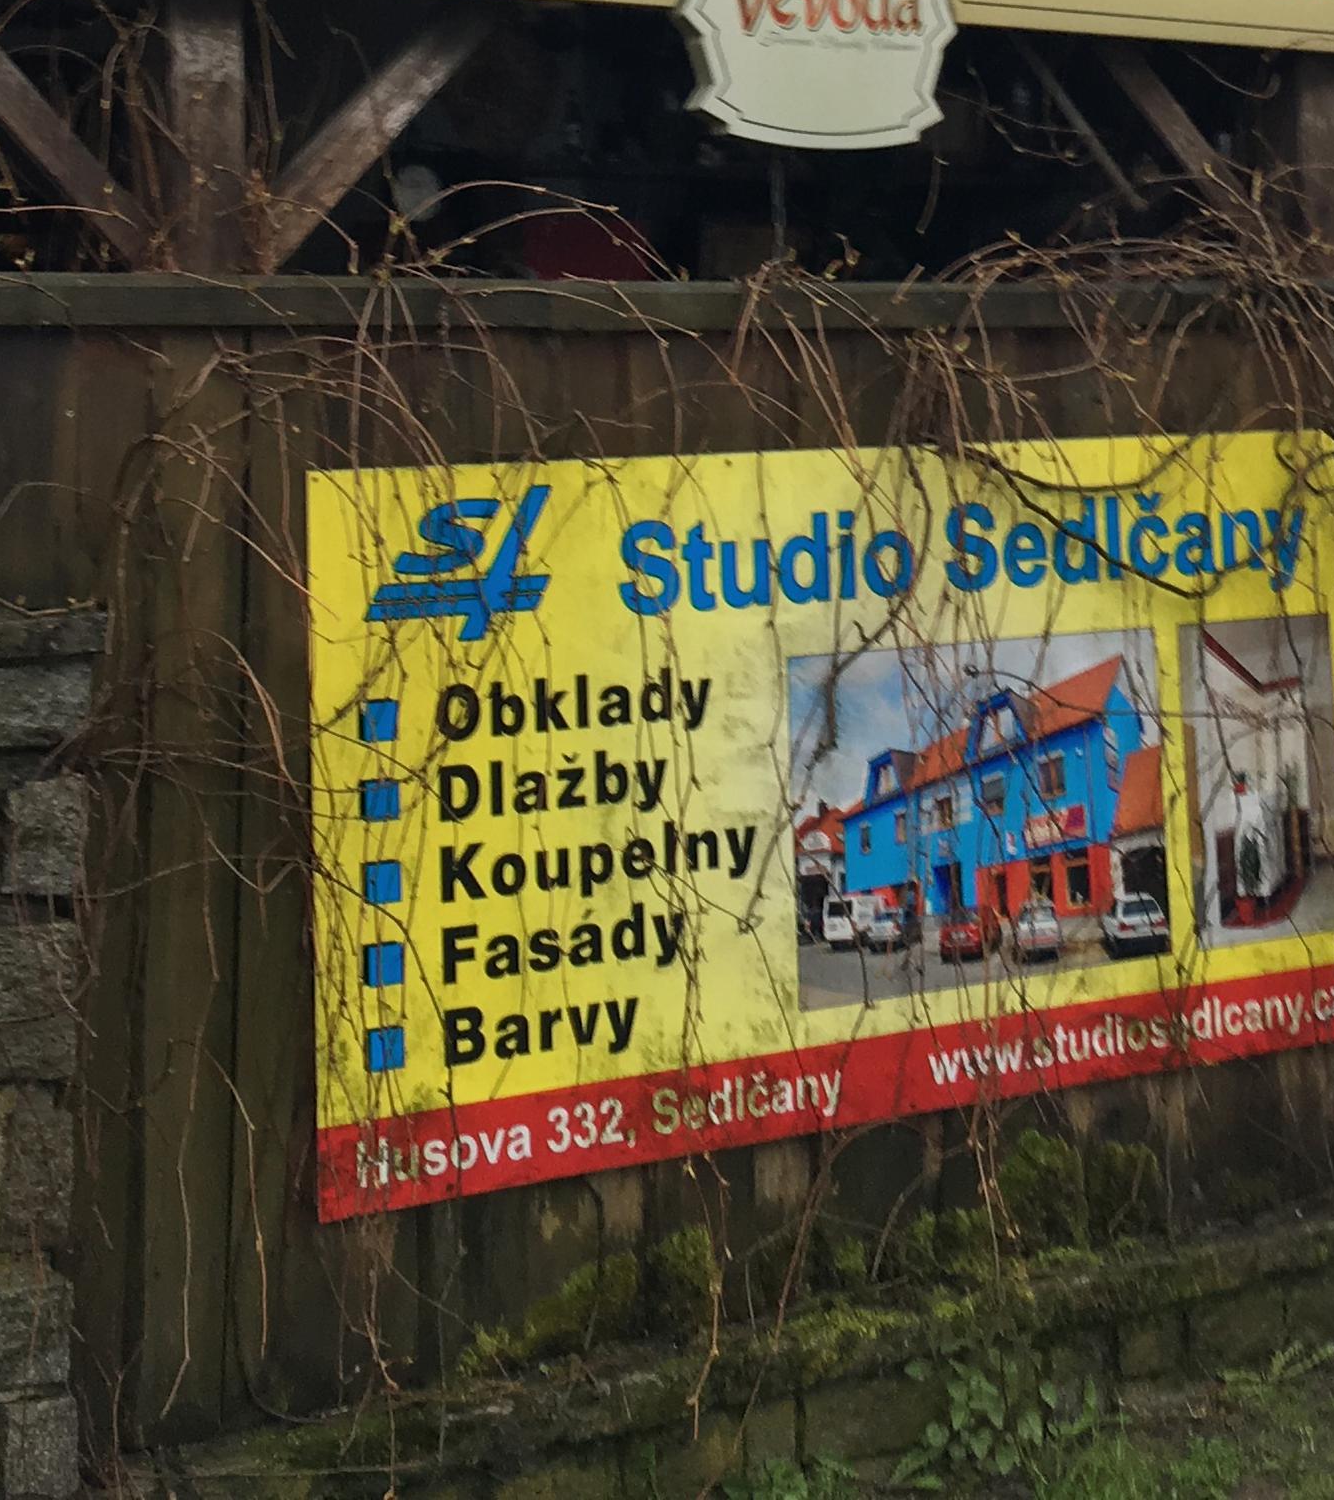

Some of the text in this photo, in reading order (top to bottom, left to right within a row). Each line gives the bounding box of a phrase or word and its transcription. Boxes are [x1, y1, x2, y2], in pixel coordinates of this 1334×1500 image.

[619, 492, 1306, 617] Studio Sedlčany
[438, 667, 711, 742] Obklady
[438, 751, 668, 823] Dlažby
[439, 820, 756, 903] Koupelny
[441, 902, 685, 985] Fasády
[444, 997, 640, 1067] Barvy
[355, 1069, 843, 1188] Husova 332, Sedlčany
